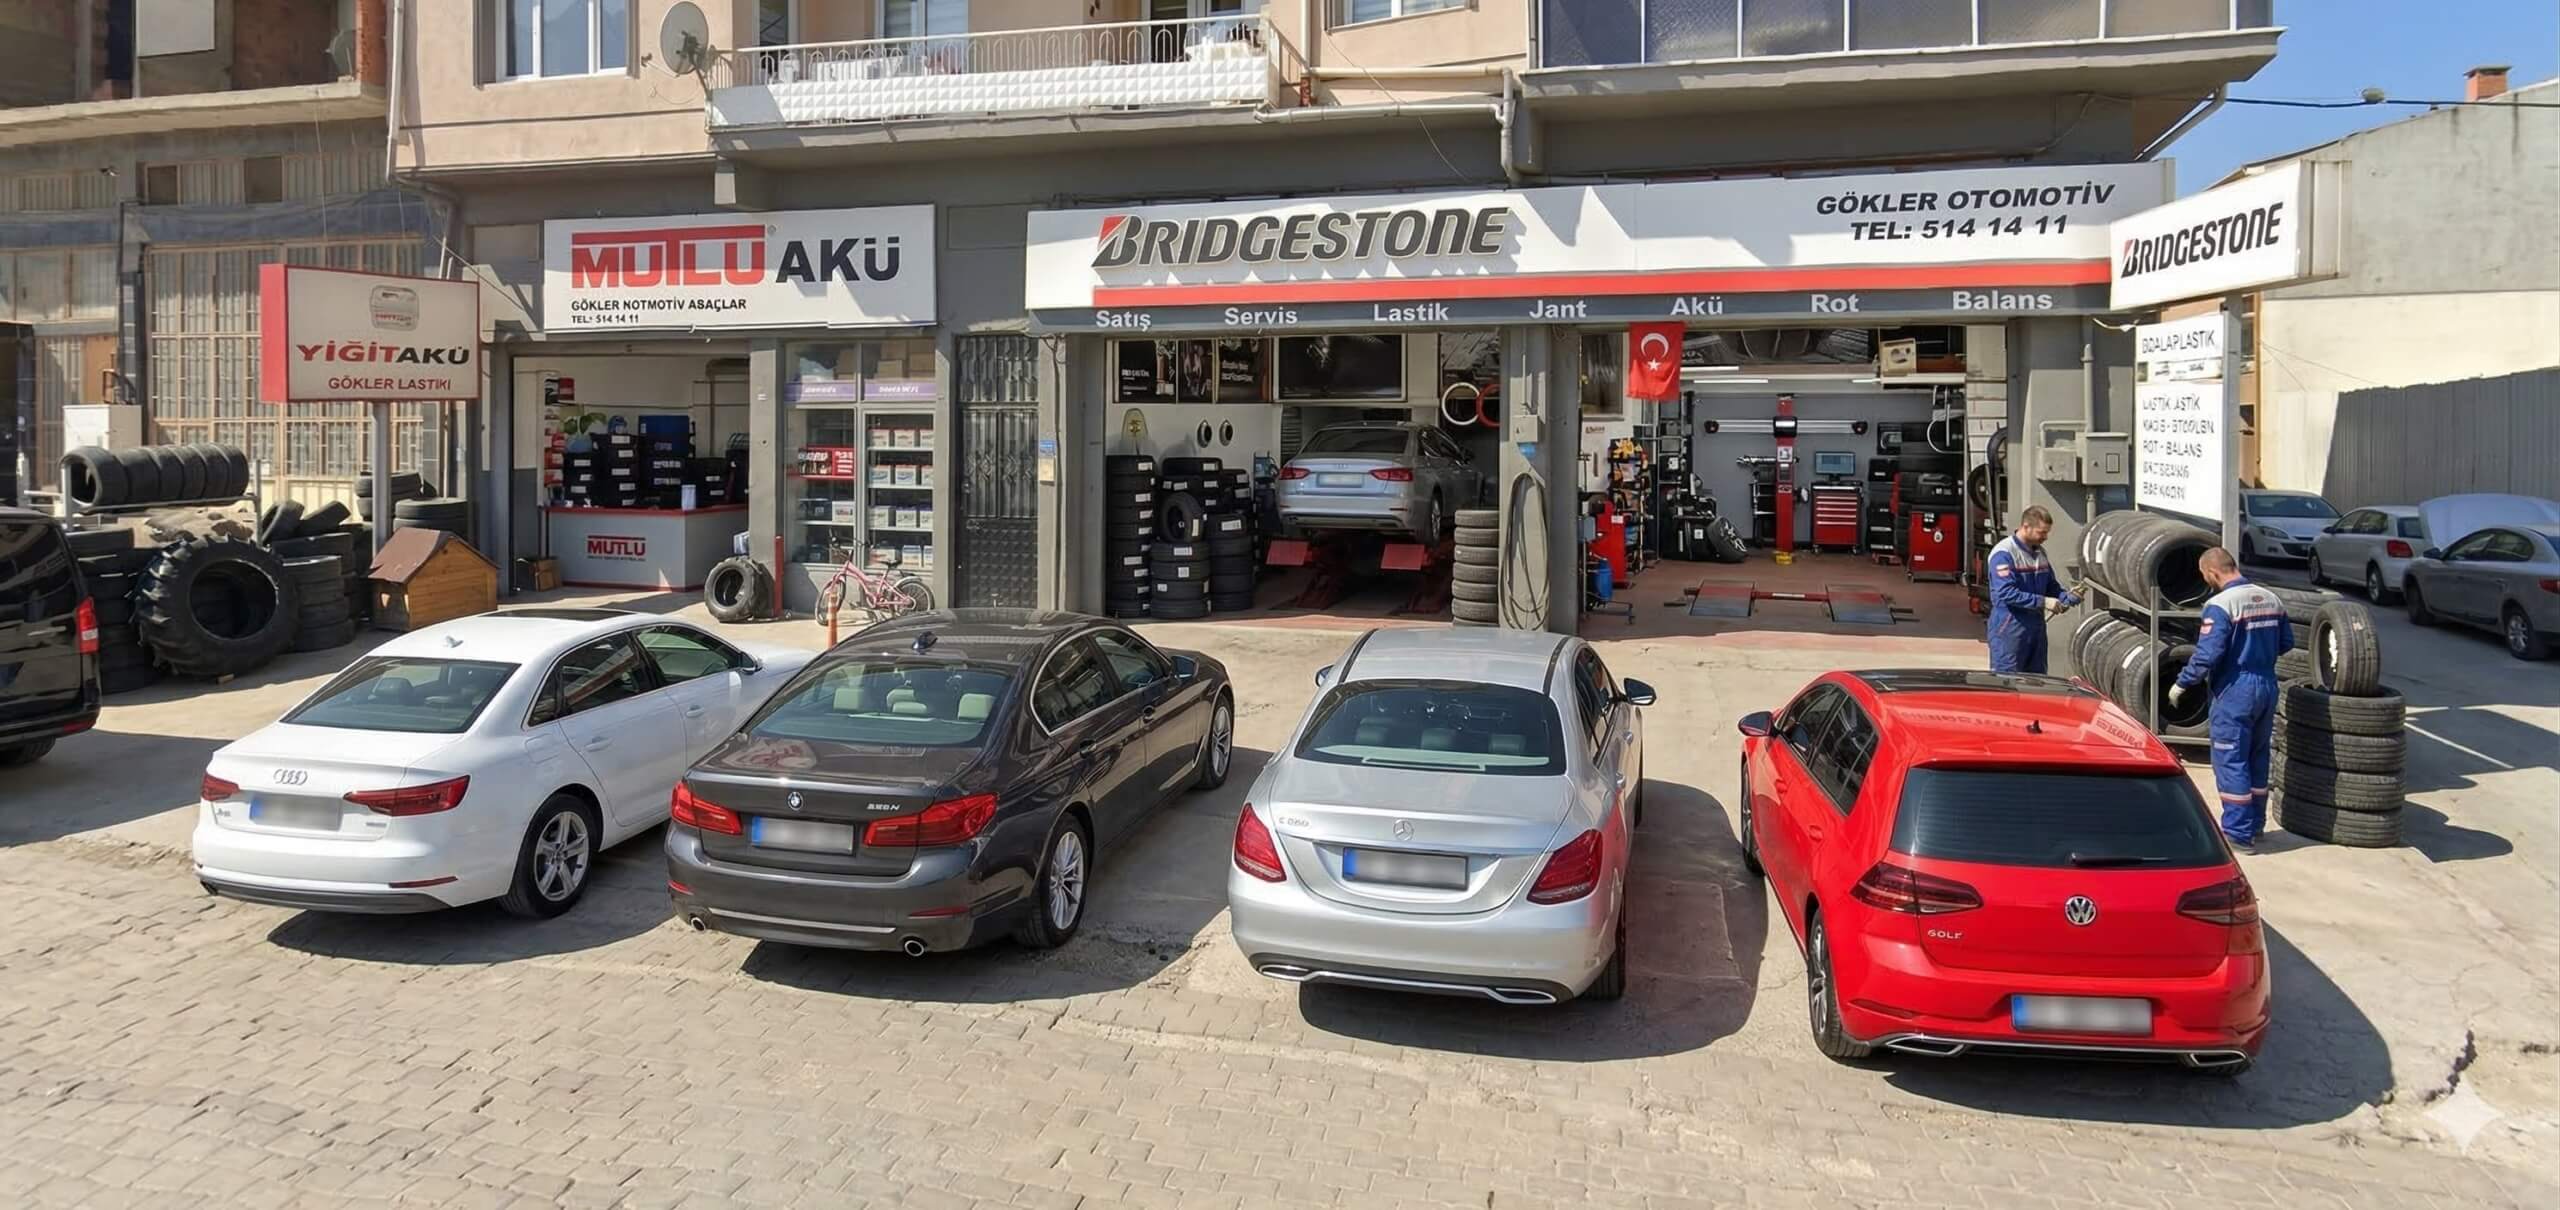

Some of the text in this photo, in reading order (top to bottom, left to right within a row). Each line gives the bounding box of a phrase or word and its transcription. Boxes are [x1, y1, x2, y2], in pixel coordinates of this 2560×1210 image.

[1817, 180, 2115, 215] GÖKLER OTOMOTİV
[1092, 206, 1509, 267] BRIDGESTONE
[1850, 214, 2068, 241] TEL: 514 14 11
[2121, 202, 2284, 279] BRIDGESTONE
[571, 226, 901, 288] MUTLU AKÜ
[571, 298, 620, 311] GÖKLER
[615, 314, 626, 323] 14
[629, 314, 639, 323] 11
[1096, 289, 2054, 332] Satış Servis Lastik Jant Akü Rot Balans
[328, 374, 394, 390] GÖKLER
[587, 536, 646, 557] MUTLU
